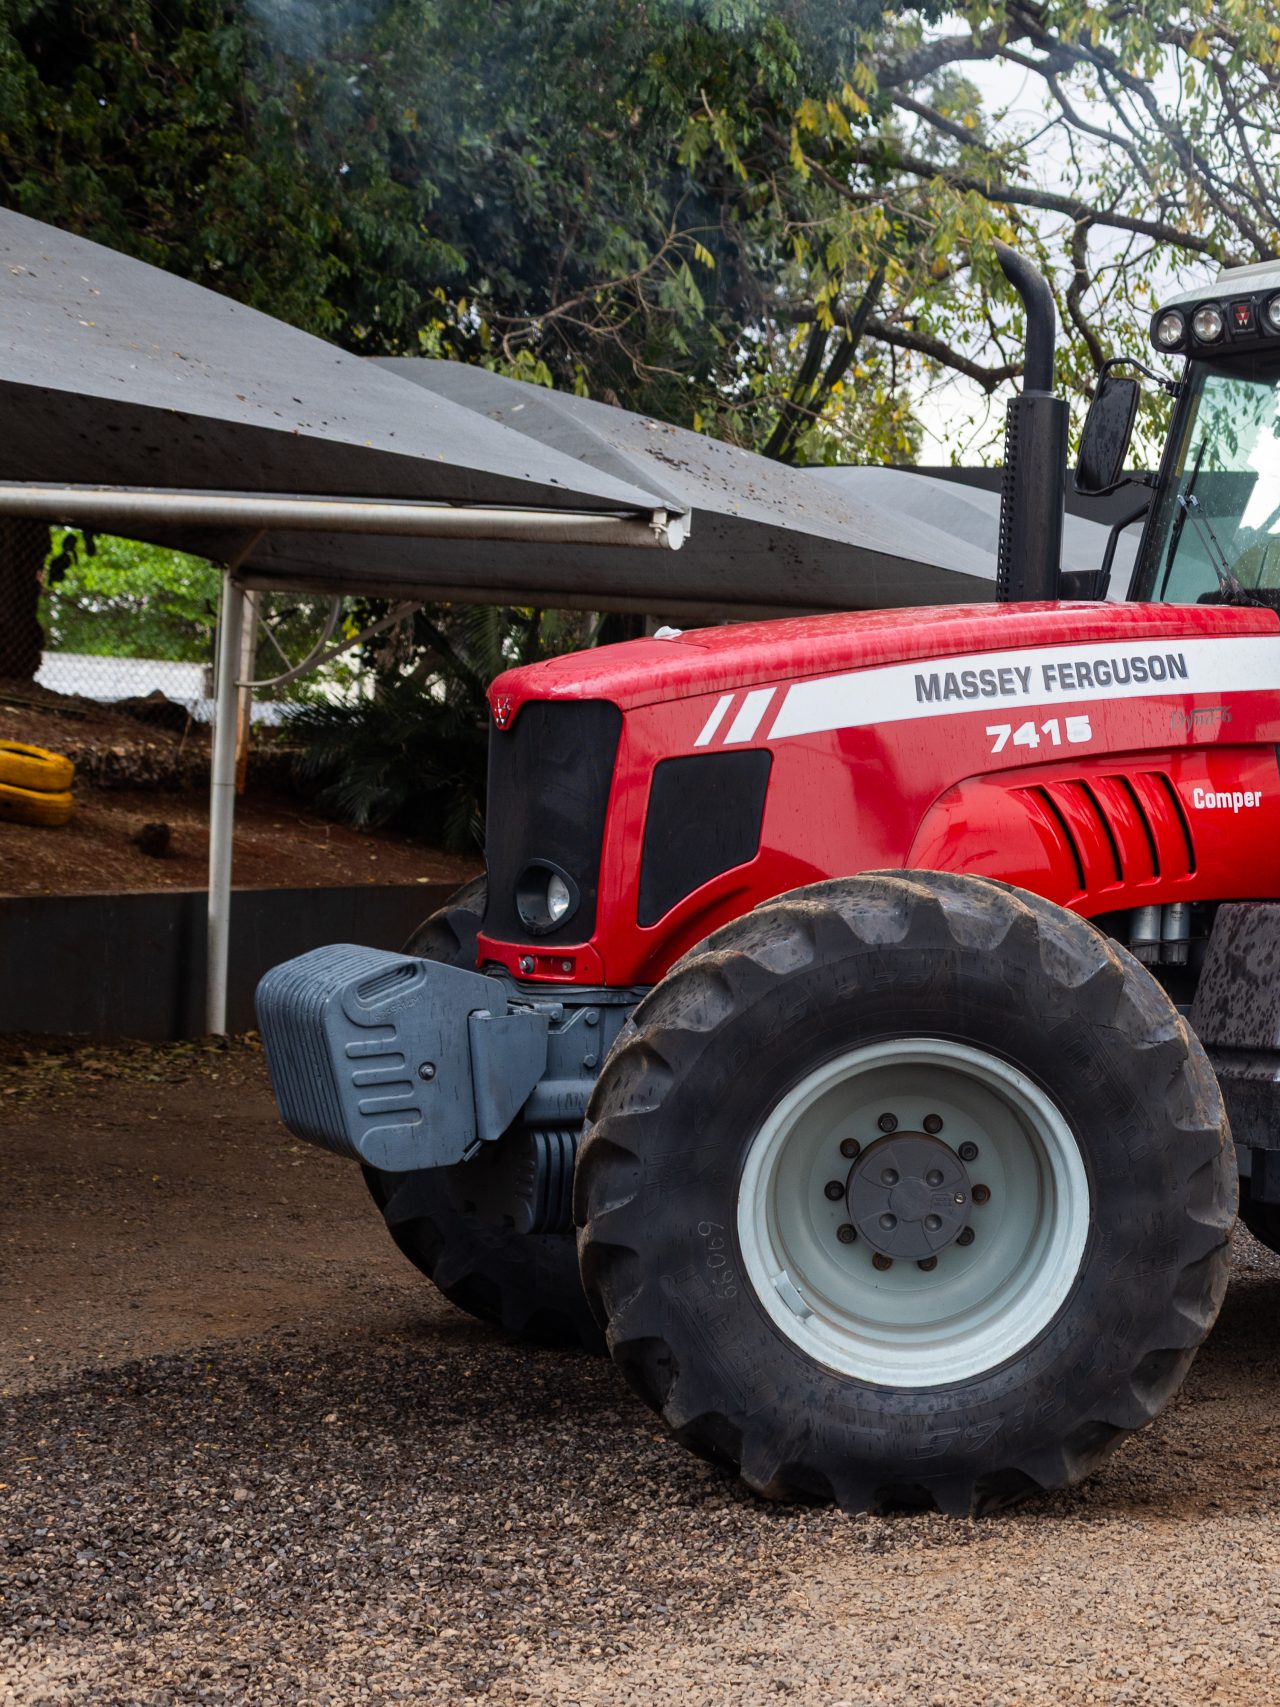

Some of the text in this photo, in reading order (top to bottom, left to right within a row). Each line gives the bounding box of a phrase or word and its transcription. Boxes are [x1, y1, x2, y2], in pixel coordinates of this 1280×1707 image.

[914, 653, 1189, 703] MASSEY FERGUSON
[985, 714, 1093, 754] 7415
[1192, 787, 1263, 814] Comper
